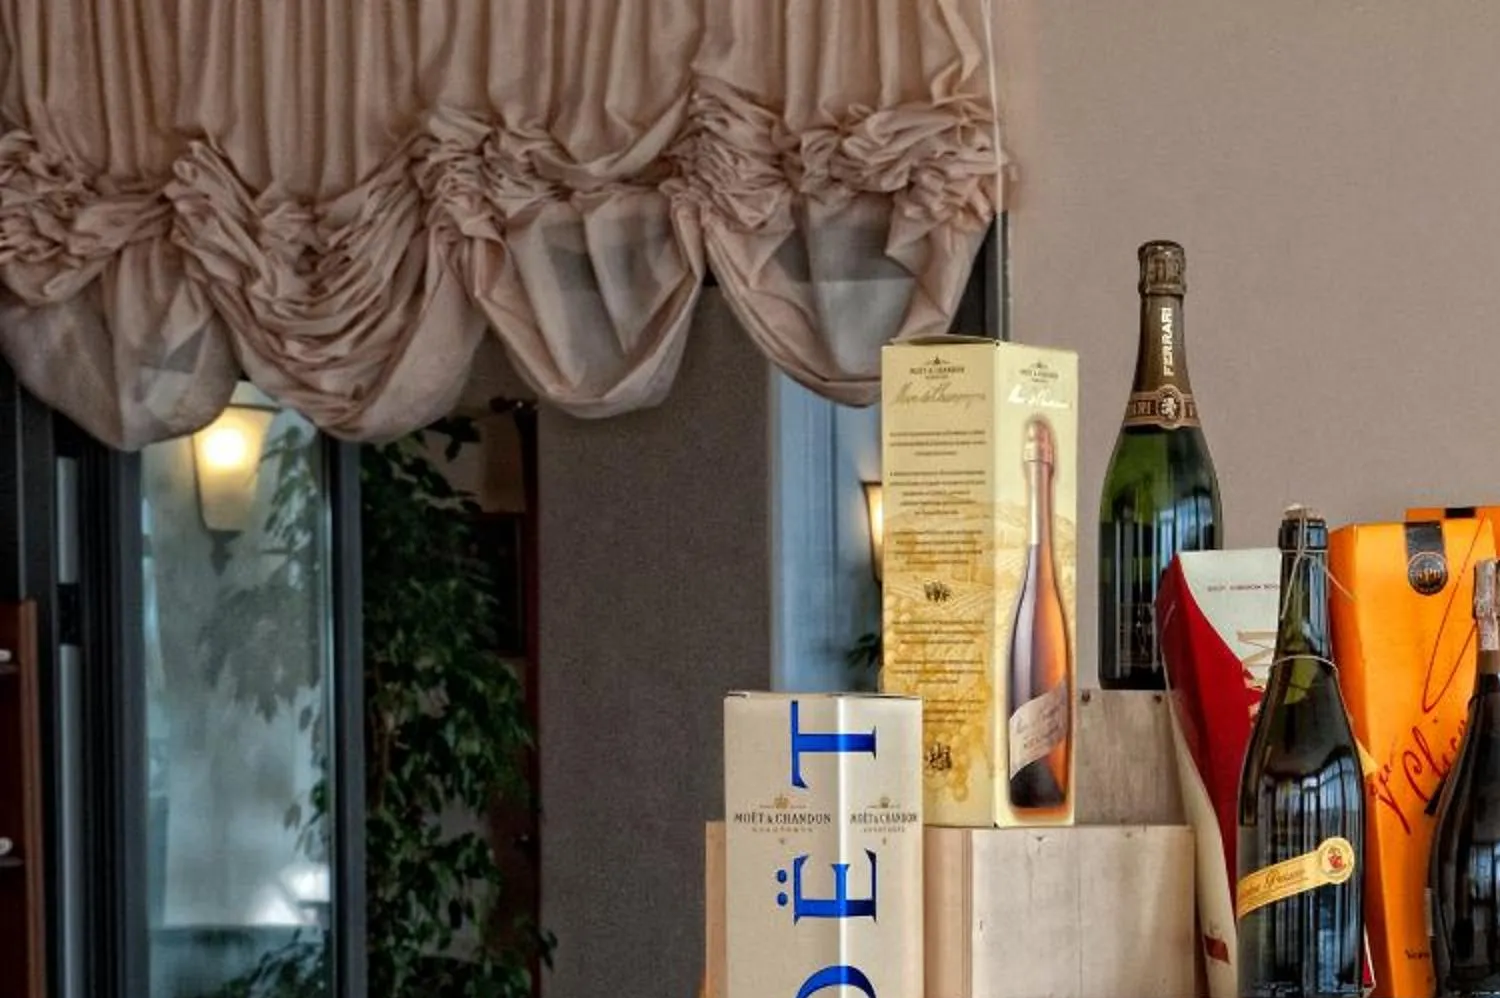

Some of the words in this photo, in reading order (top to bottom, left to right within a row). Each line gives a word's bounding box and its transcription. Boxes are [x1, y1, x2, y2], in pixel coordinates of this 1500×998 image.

[1160, 307, 1175, 378] FERRARI
[733, 810, 763, 824] MOËT
[775, 812, 831, 824] CHANDON
